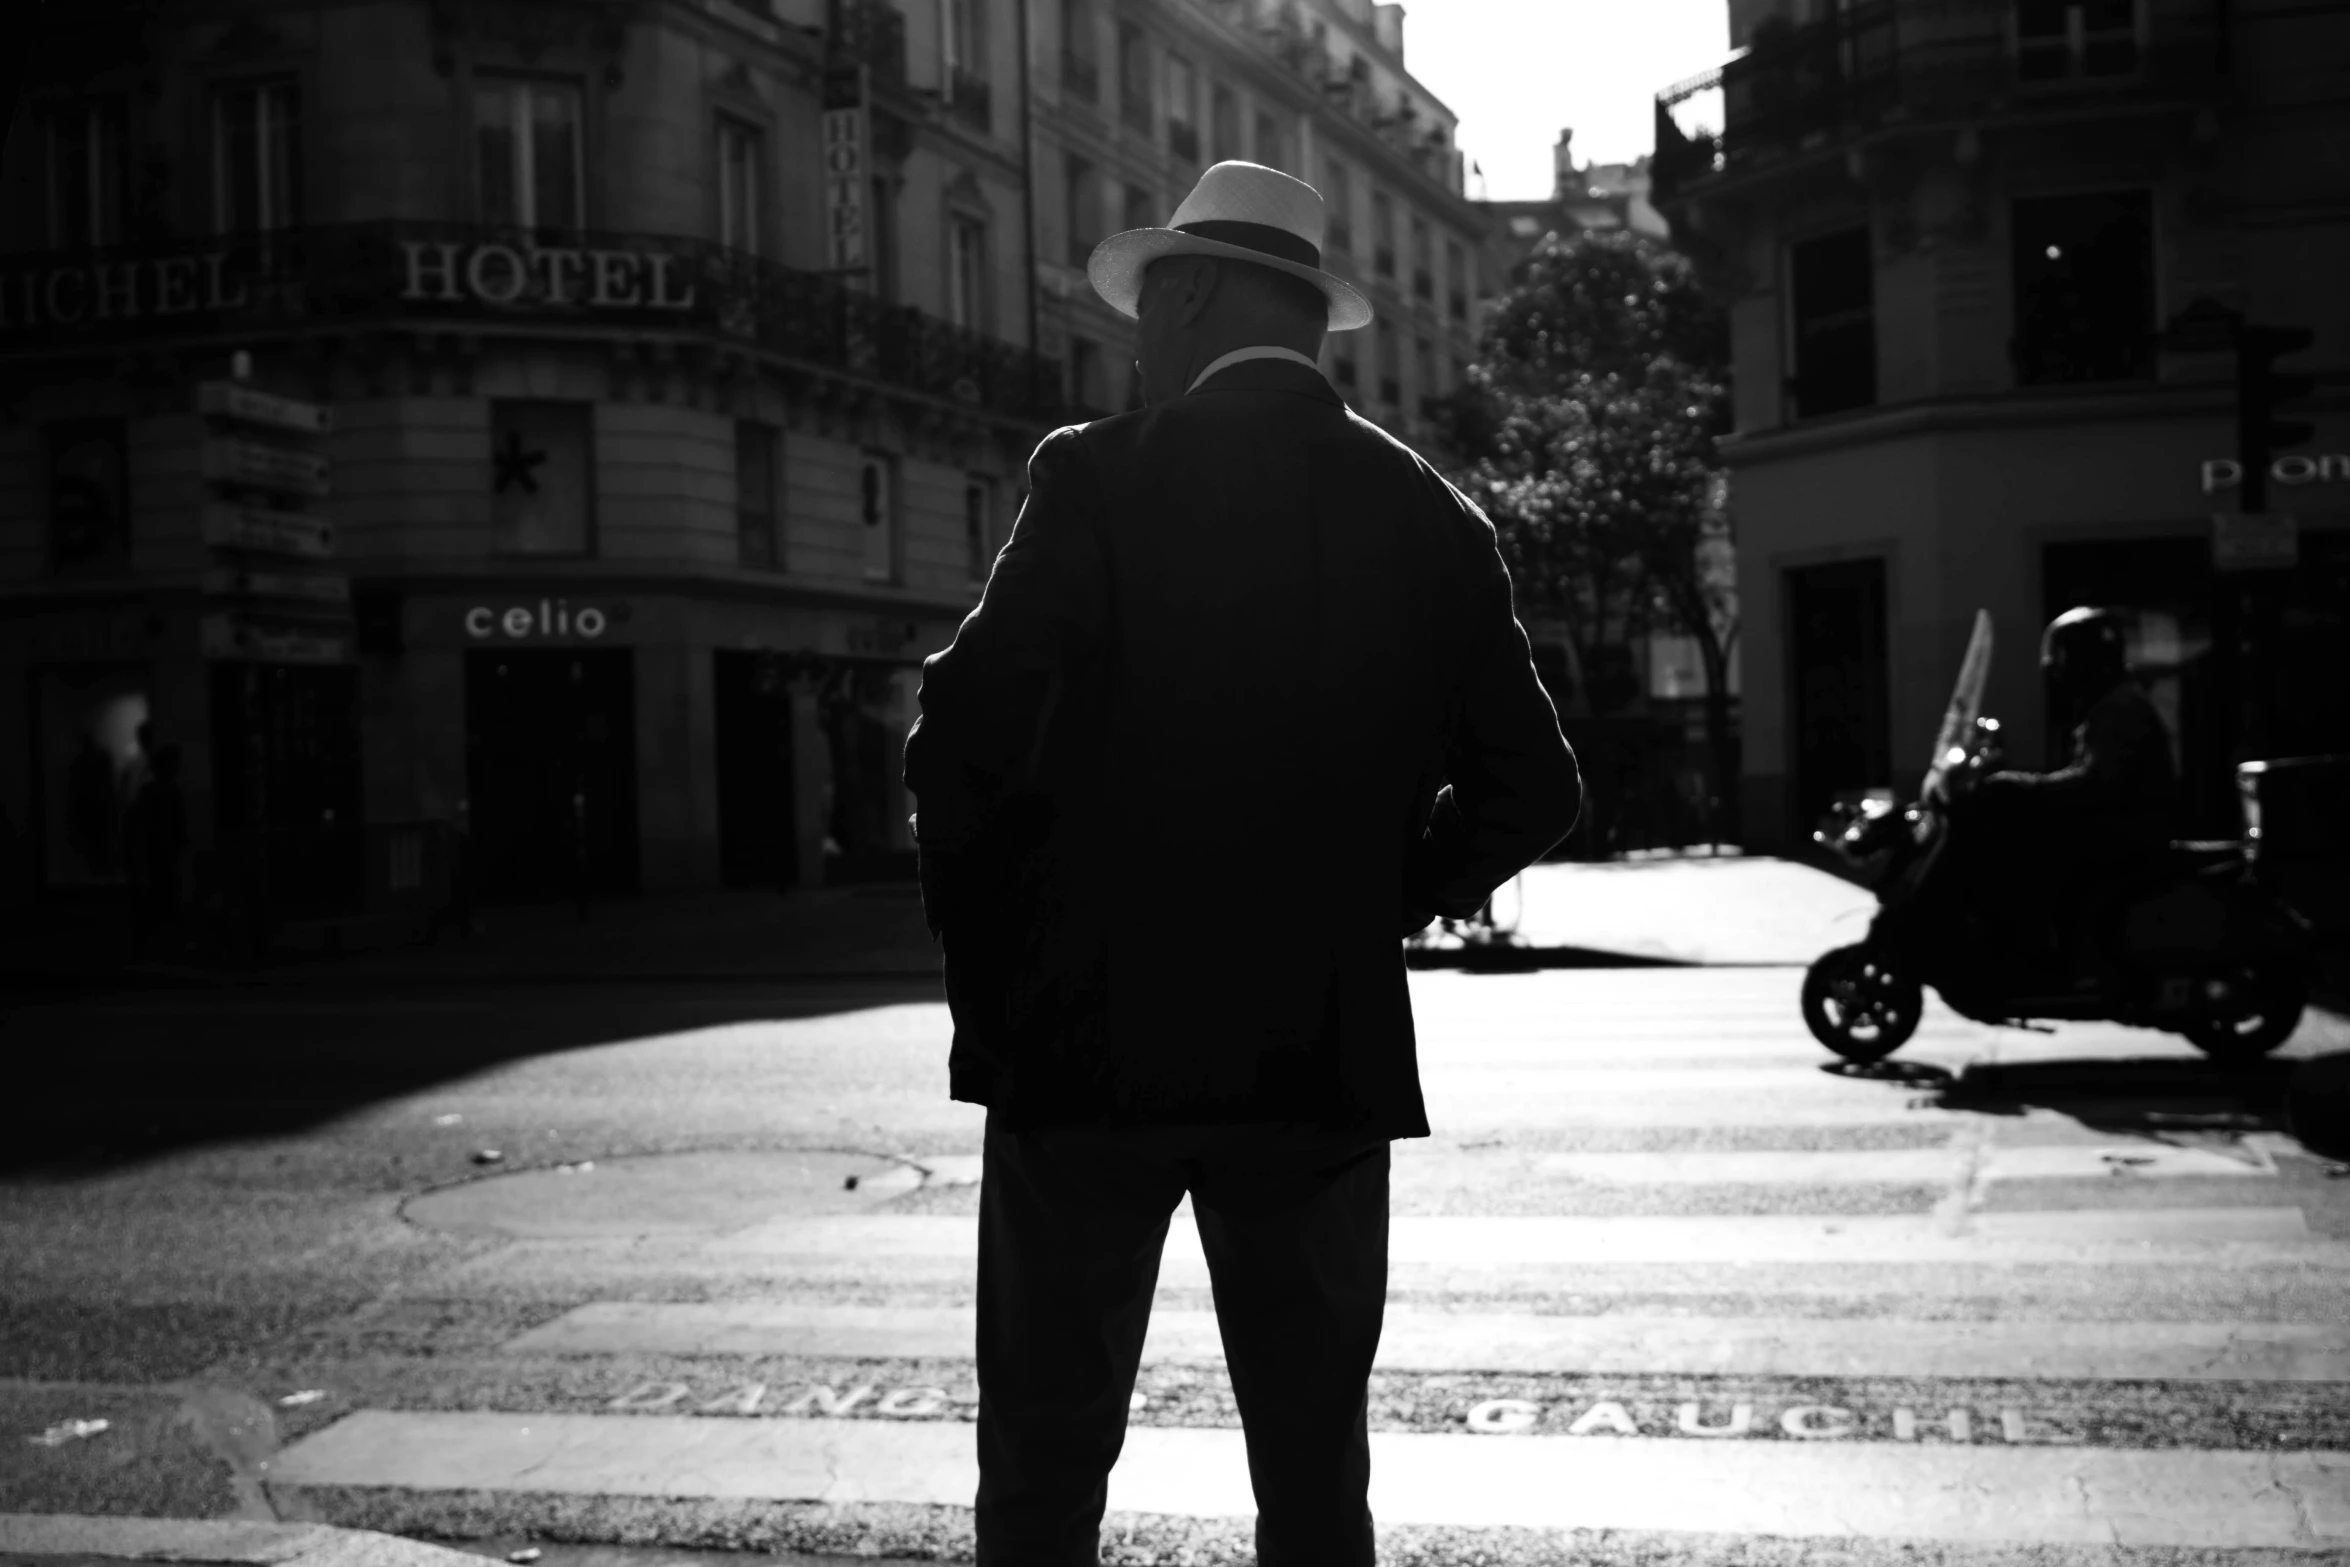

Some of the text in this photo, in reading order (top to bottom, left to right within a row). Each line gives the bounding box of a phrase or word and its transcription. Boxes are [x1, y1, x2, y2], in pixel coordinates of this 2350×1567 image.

[827, 113, 861, 268] HOTEL
[0, 251, 248, 330] ICHEL
[401, 240, 696, 310] HOTEL
[465, 597, 606, 639] celio
[1466, 1398, 2084, 1443] GAUCHE
